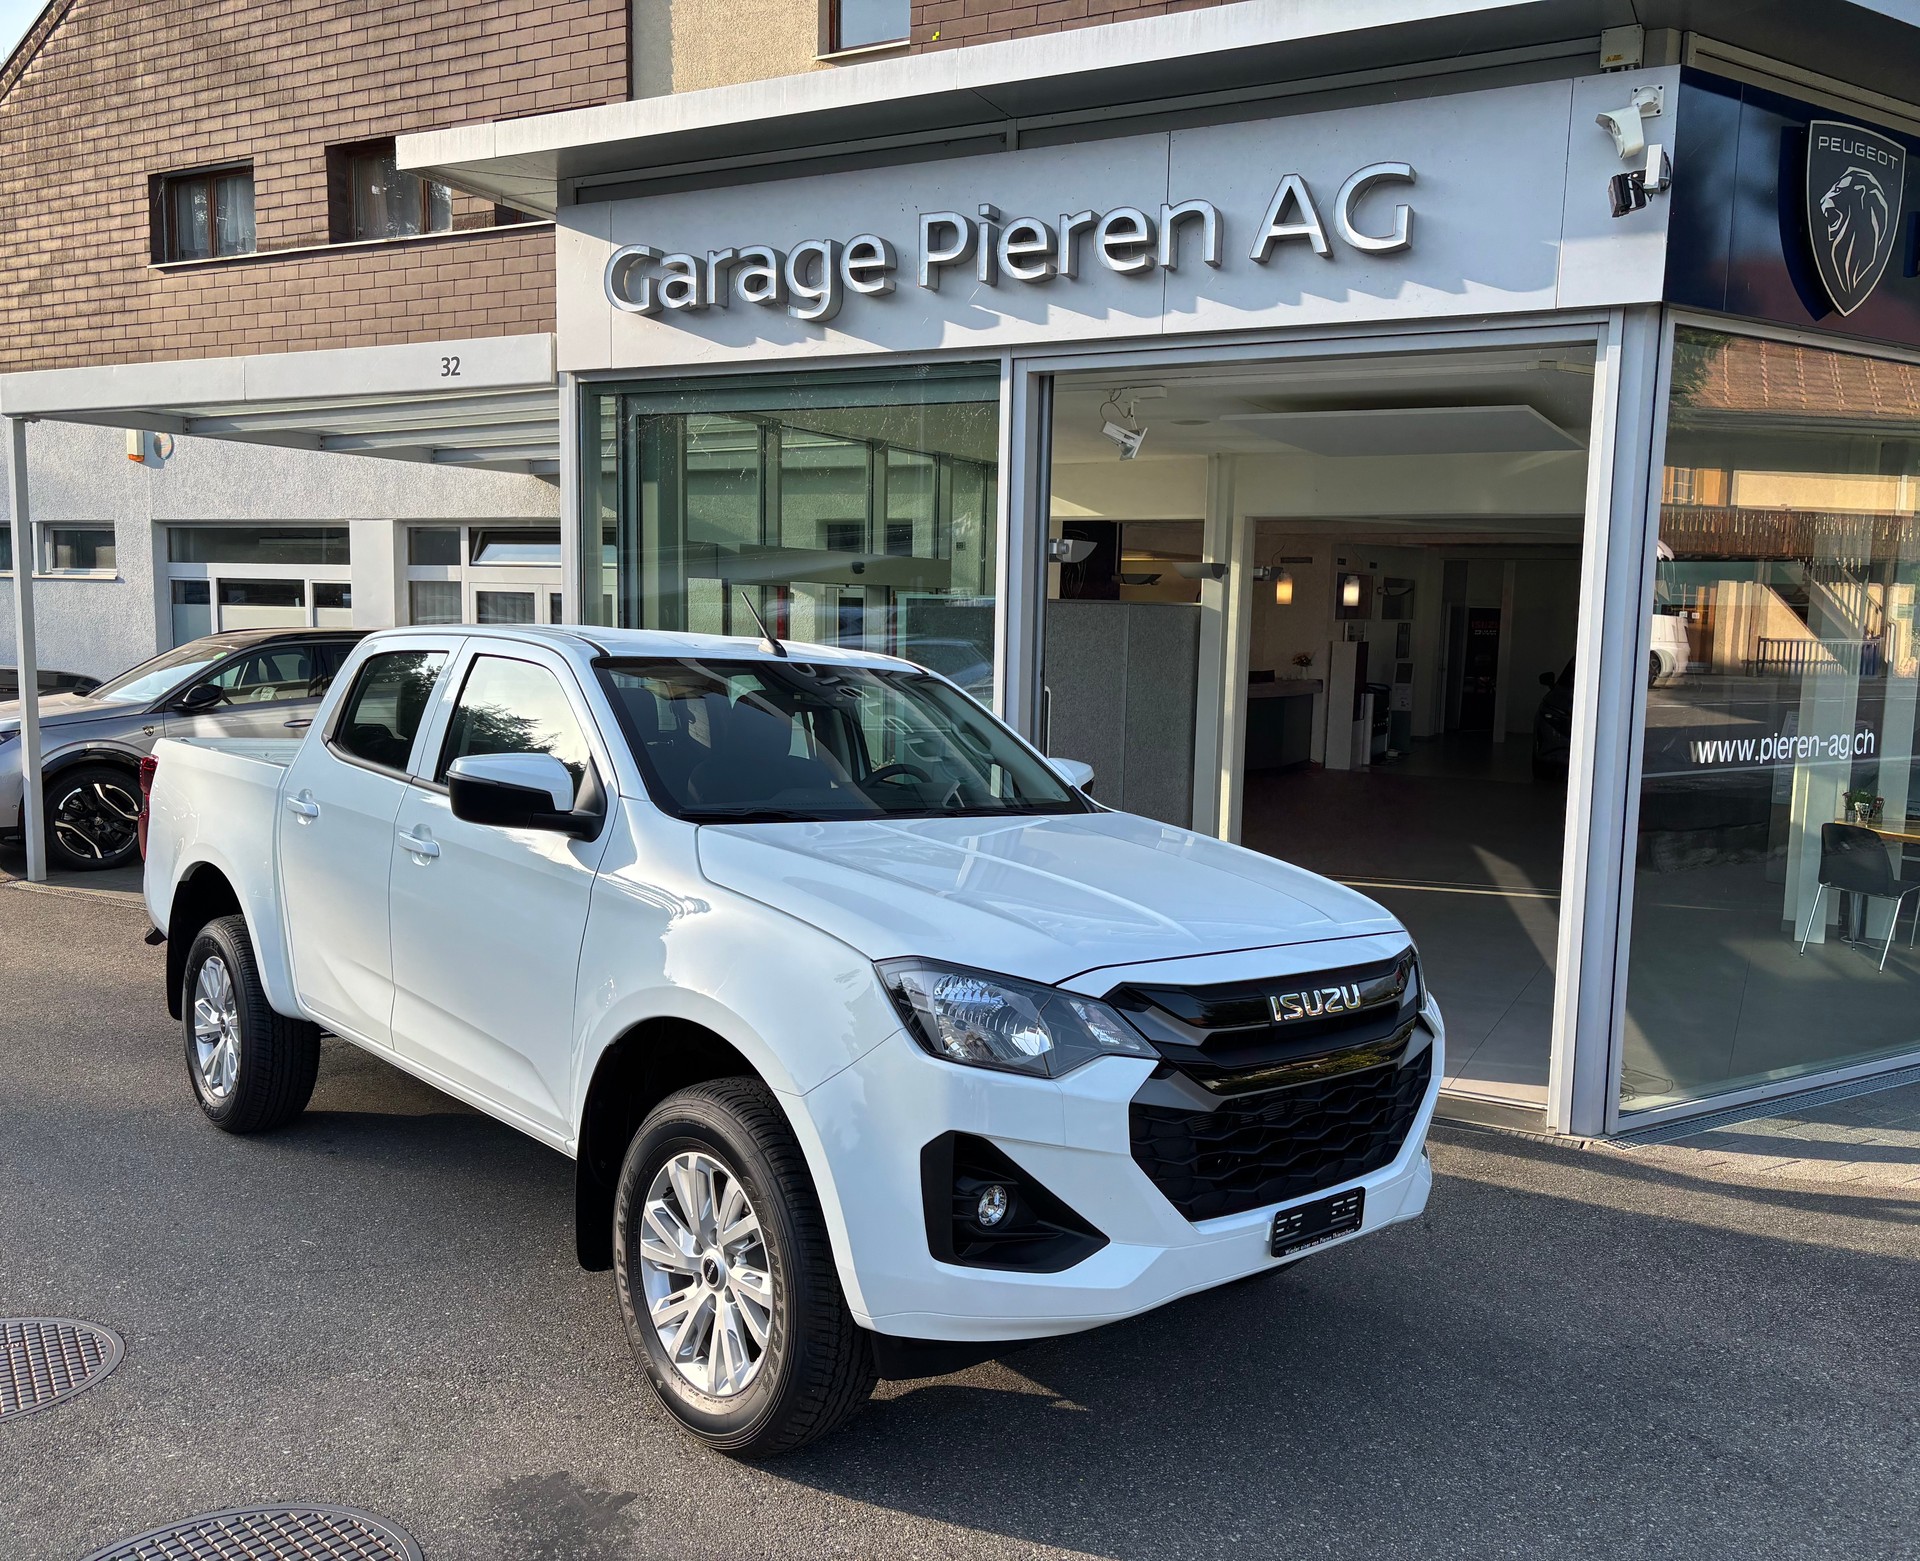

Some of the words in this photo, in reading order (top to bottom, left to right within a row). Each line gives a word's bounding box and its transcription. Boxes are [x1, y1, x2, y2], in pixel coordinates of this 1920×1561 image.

[1817, 136, 1899, 170] PEUGEOT
[603, 233, 897, 323] Garage
[917, 199, 1224, 292] Pieren
[1248, 161, 1416, 263] AG
[440, 356, 461, 377] 32
[1697, 729, 1875, 764] www.pieren-ag.ch
[1268, 983, 1361, 1022] ISUZU
